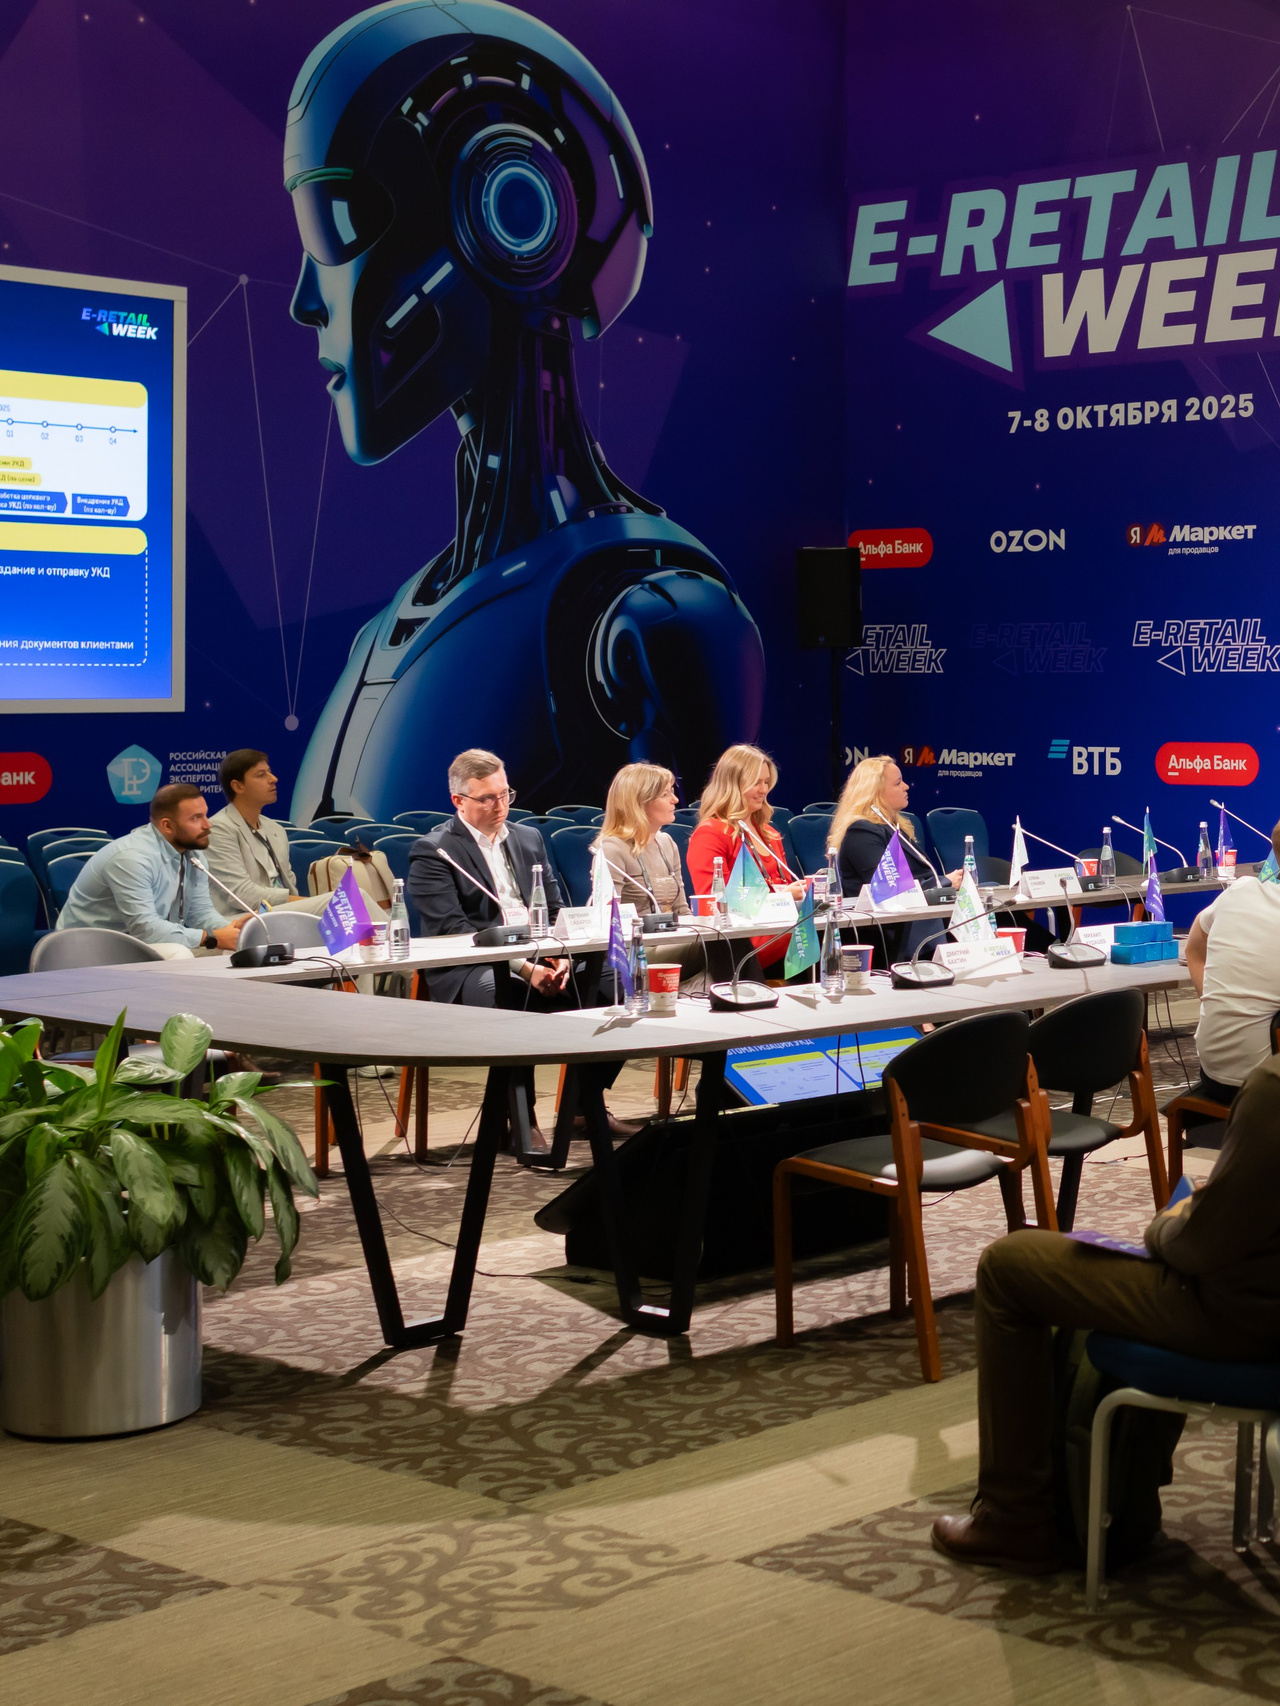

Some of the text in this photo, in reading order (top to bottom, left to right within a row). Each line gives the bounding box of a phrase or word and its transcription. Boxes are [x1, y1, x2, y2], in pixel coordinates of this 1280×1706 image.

[81, 308, 150, 326] E-RETAIL
[112, 323, 158, 340] WEEK
[1008, 393, 1255, 433] 7-8 ОКТЯБРЯ 2025
[990, 529, 1065, 553] OZON
[1169, 524, 1257, 544] Маркет
[895, 540, 923, 553] Банк
[1168, 545, 1219, 556] для продавцов
[0, 566, 35, 575] здание
[47, 568, 89, 578] отправку
[91, 568, 110, 578] УКД
[862, 624, 931, 649] ETAIL
[1132, 618, 1266, 646] E-RETAIL
[21, 640, 134, 650] документов клиентами
[869, 649, 947, 674] WEEK
[170, 750, 226, 760] РОССИЙСКАЯ
[938, 749, 1016, 768] Маркет
[1072, 746, 1122, 776] ВТБ
[1168, 754, 1247, 773] Альфа Банк
[170, 774, 216, 783] ЭКСПЕРТОВ
[950, 770, 982, 778] продавцов
[881, 861, 897, 888] WEEK
[335, 904, 354, 936] WEEK
